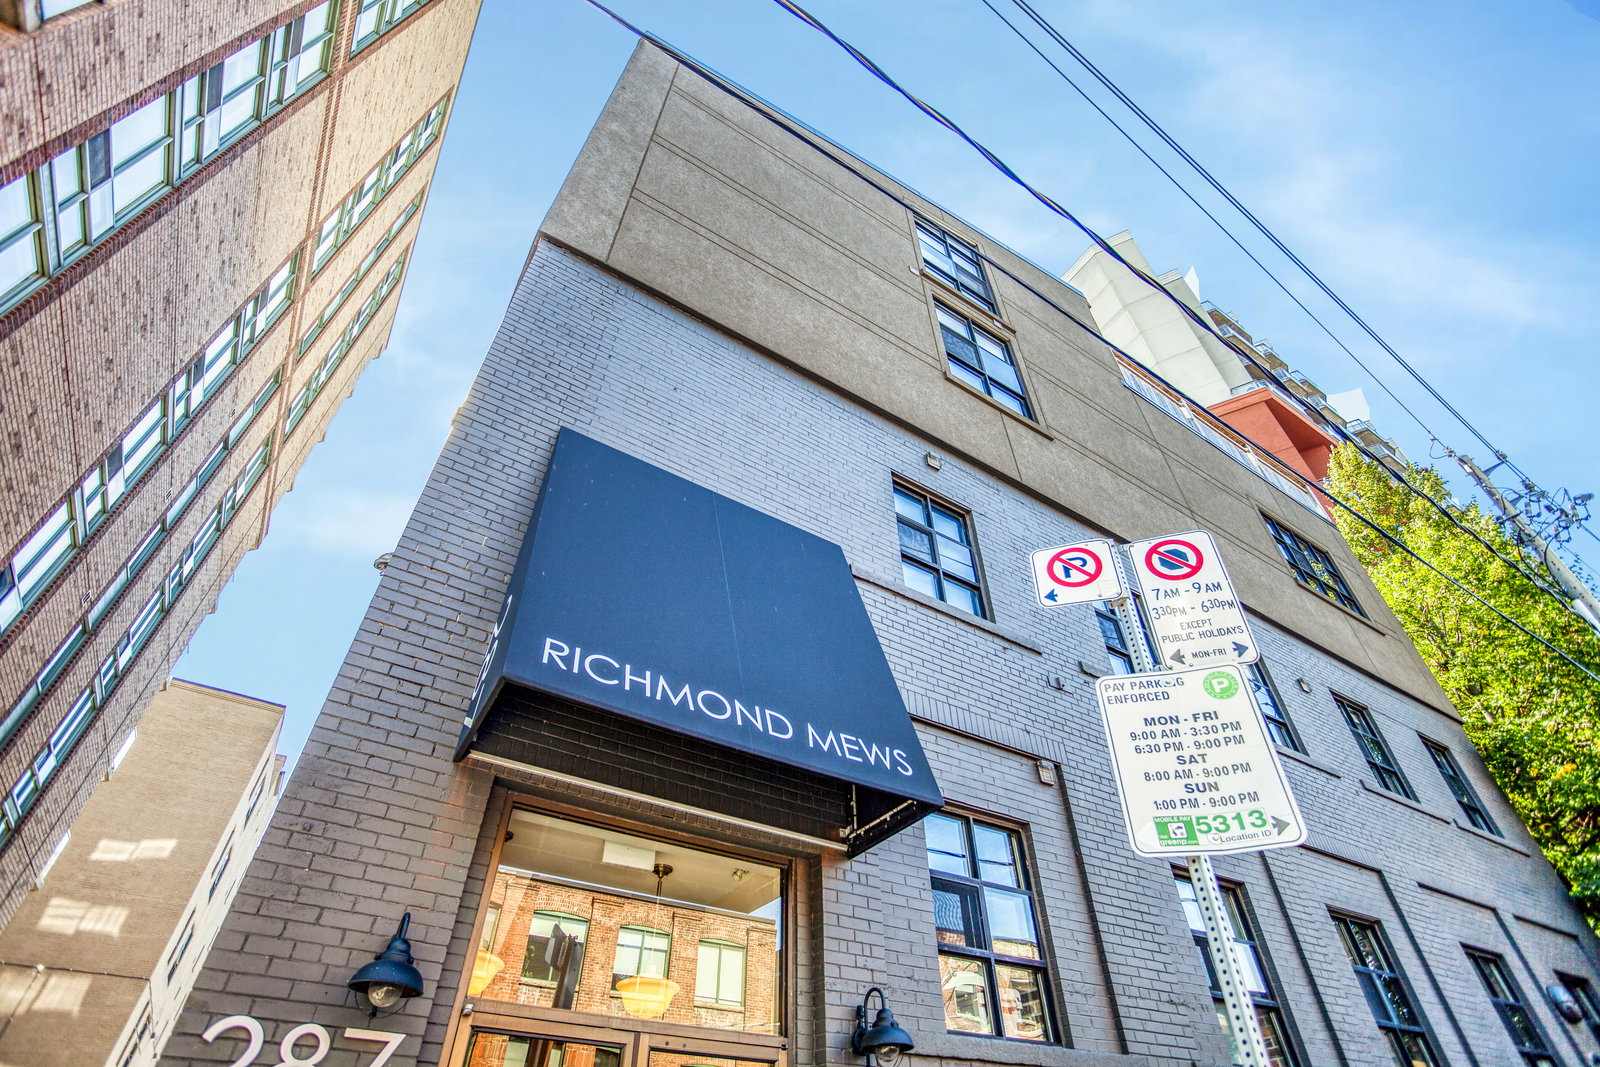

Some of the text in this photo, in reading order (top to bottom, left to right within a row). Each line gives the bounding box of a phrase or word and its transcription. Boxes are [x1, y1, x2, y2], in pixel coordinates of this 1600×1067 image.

[1180, 618, 1213, 631] EXCEPT
[1161, 625, 1244, 644] PUBLIC HOLIDAYS
[1191, 648, 1227, 659] MON-FRI
[1104, 677, 1184, 693] PAY PARKG
[1211, 677, 1230, 693] P
[1107, 691, 1170, 705] ENFORCED
[541, 637, 914, 777] RICHMOND MEWS
[1143, 715, 1180, 727] MON
[1192, 711, 1219, 723] FRI
[1129, 730, 1157, 741] 9:00
[1160, 727, 1181, 739] AM
[1190, 724, 1219, 737] 3:30
[1221, 720, 1242, 733] PM
[1134, 743, 1160, 754] 6:30
[1164, 741, 1184, 752] PM
[1194, 739, 1221, 750] 9:00
[1224, 734, 1245, 746] PM
[1176, 753, 1208, 765] SAT
[1144, 770, 1170, 781] 8:00
[1174, 767, 1193, 779] AM
[1202, 766, 1229, 778] 9:00
[1231, 762, 1252, 774] PM
[1184, 781, 1220, 794] SUN
[1153, 800, 1177, 810] 1:00
[1180, 797, 1200, 809] PM
[1209, 795, 1236, 807] 9:00
[1239, 791, 1260, 803] PM
[1195, 810, 1267, 834] 5313
[1220, 829, 1272, 843] Location ID
